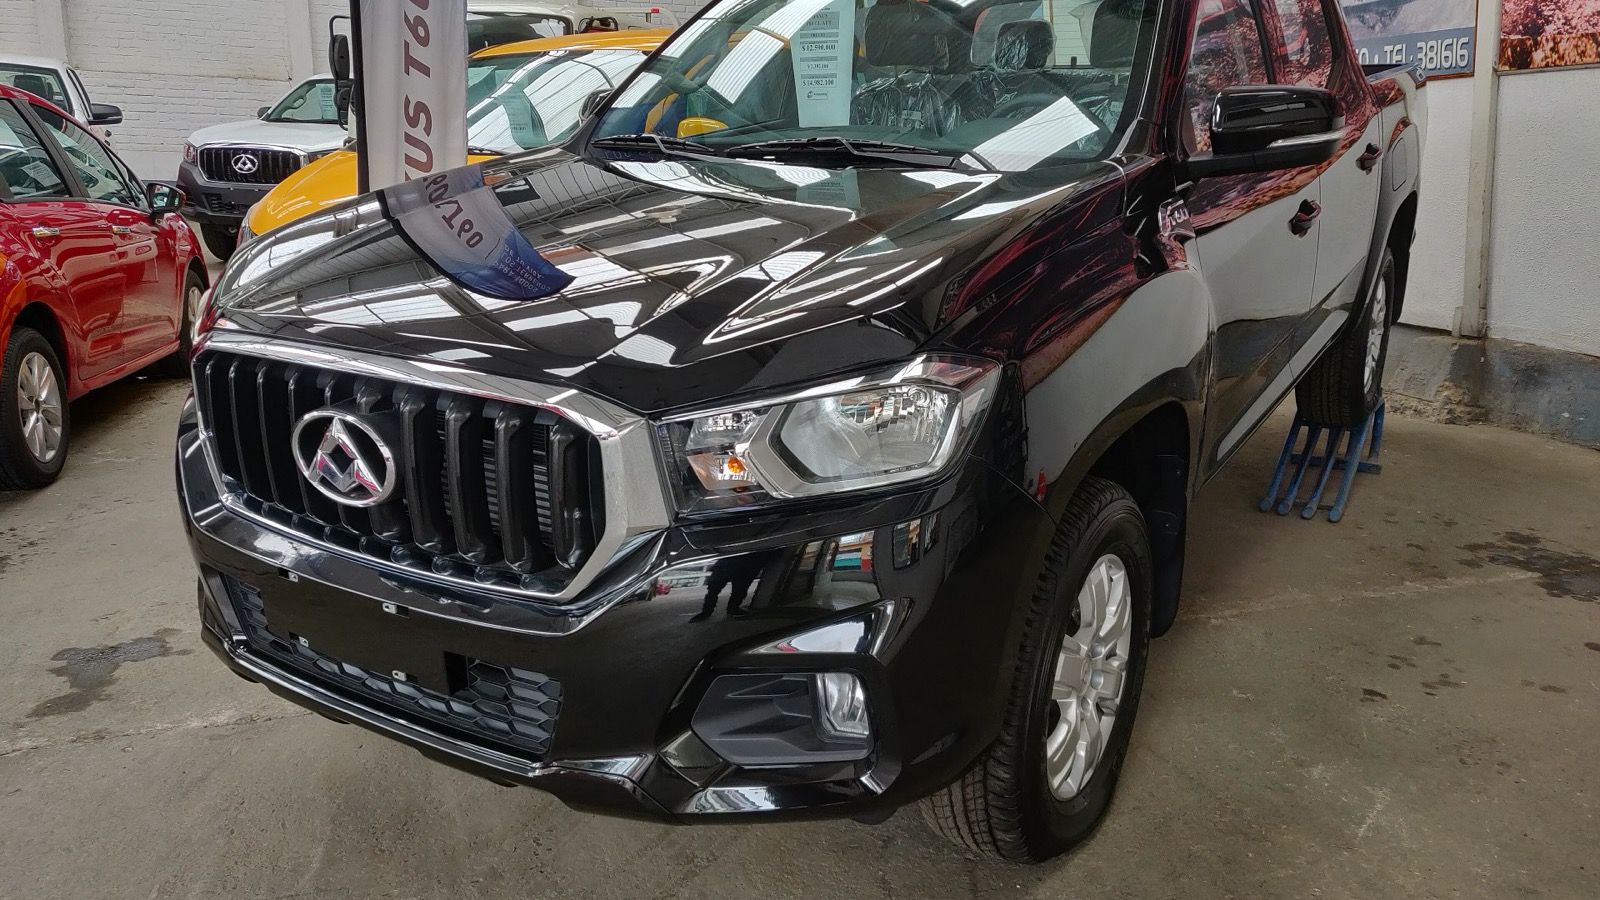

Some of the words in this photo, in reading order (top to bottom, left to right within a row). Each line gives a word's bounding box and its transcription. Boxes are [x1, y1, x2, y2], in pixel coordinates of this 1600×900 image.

[404, 0, 431, 79] T6
[1417, 37, 1469, 71] 381616
[404, 94, 434, 182] US
